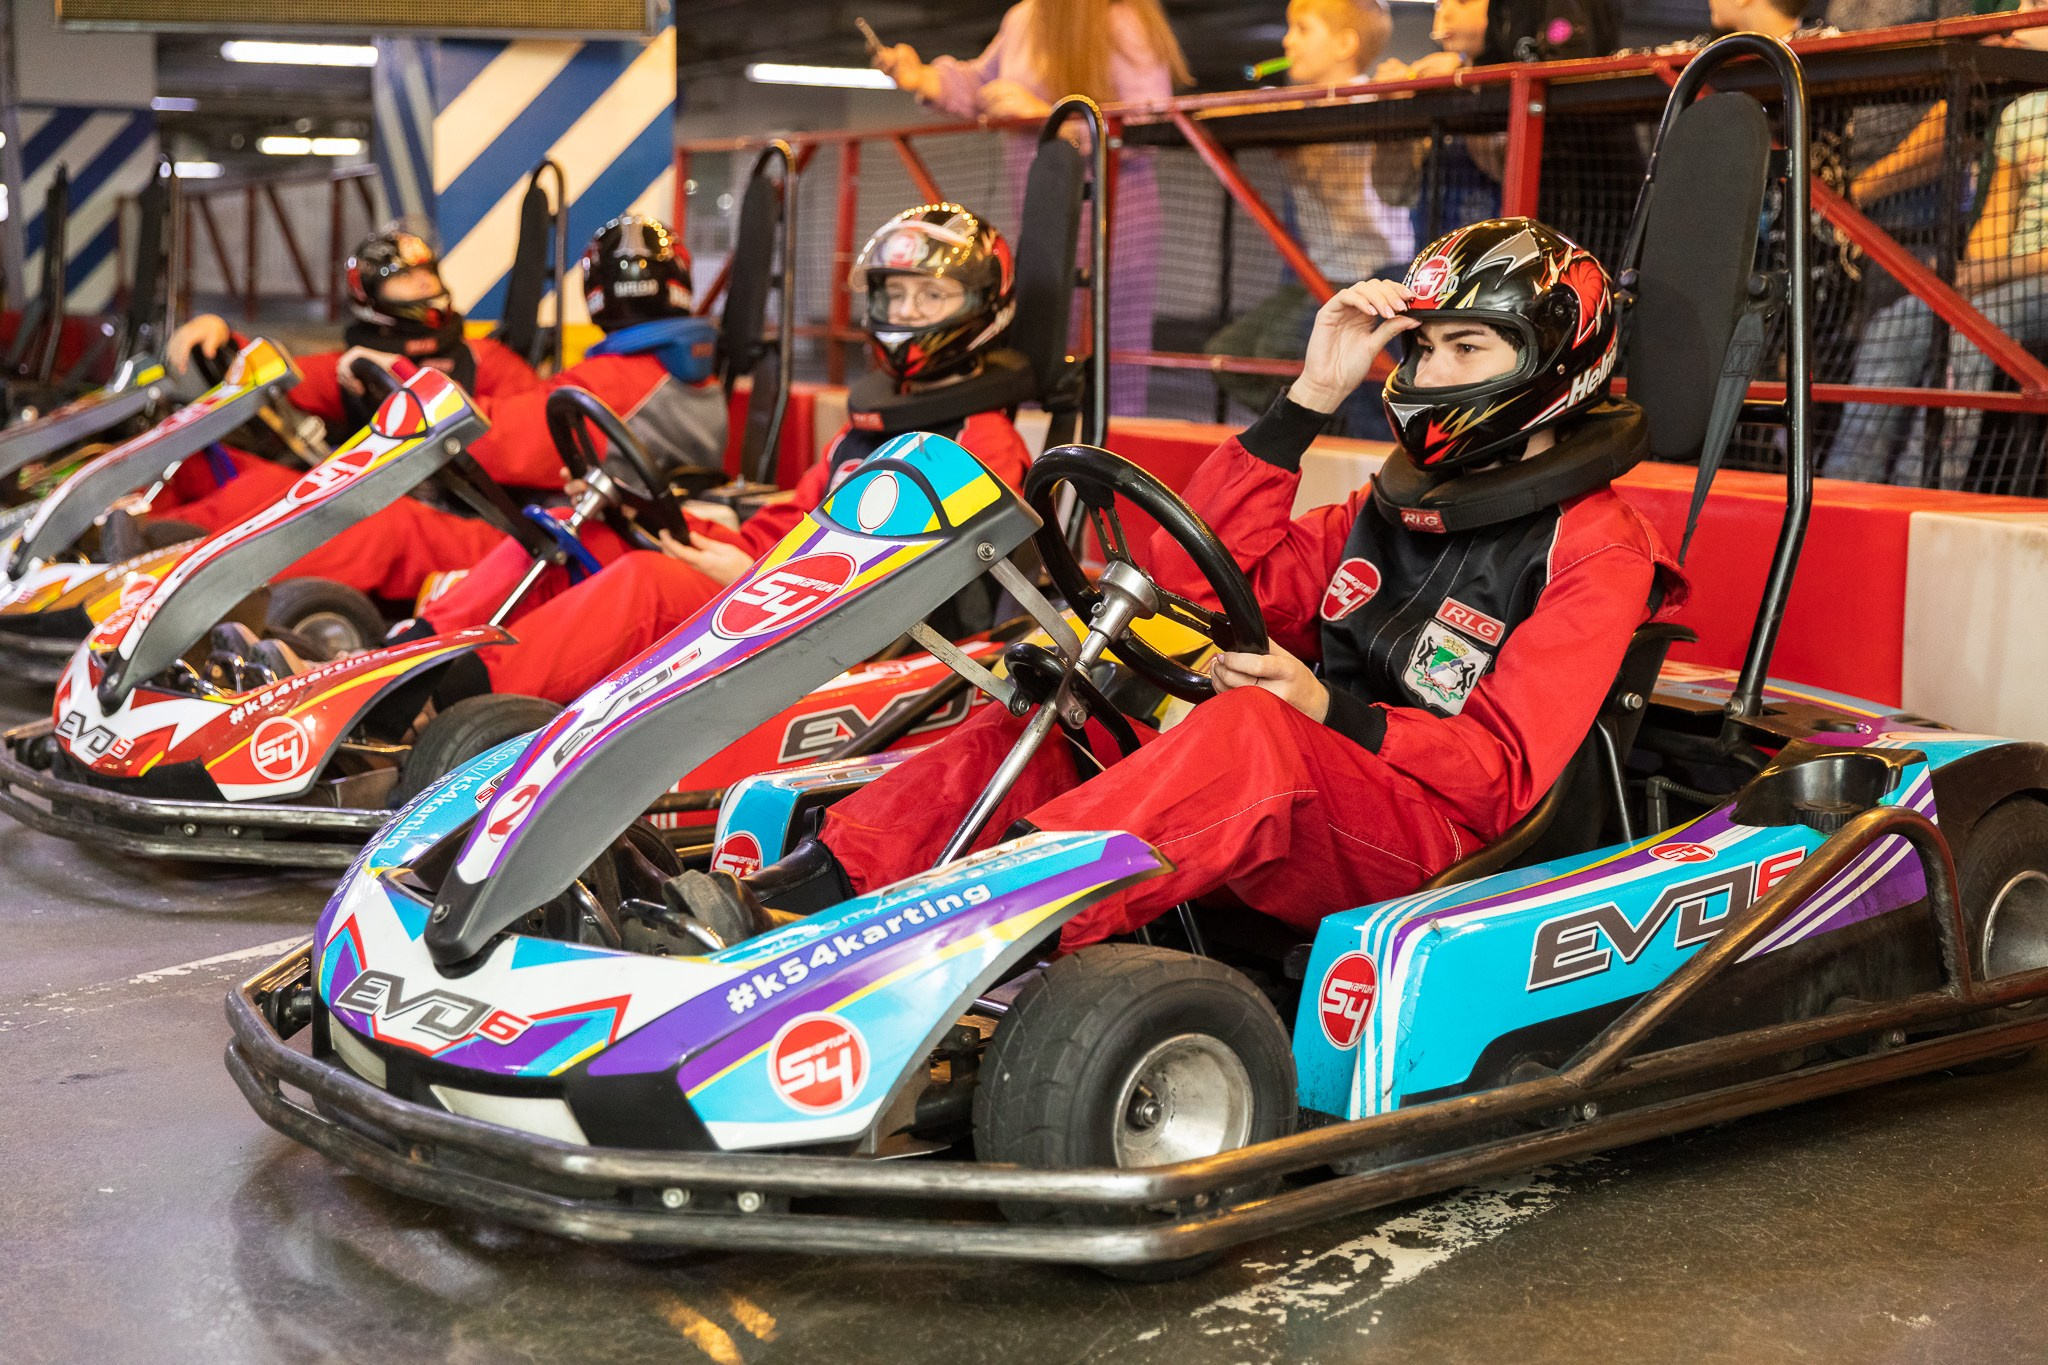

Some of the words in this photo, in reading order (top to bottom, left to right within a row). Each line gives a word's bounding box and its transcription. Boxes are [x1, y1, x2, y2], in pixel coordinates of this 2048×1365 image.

[733, 571, 820, 633] 54
[1329, 569, 1364, 619] 54
[1444, 605, 1497, 638] RLG
[778, 685, 990, 764] EVO
[257, 738, 299, 770] 54
[488, 783, 541, 836] 2
[1659, 846, 1714, 861] 54
[726, 882, 992, 1015] #k54karting
[1323, 978, 1369, 1044] 54
[779, 1046, 855, 1101] 54
